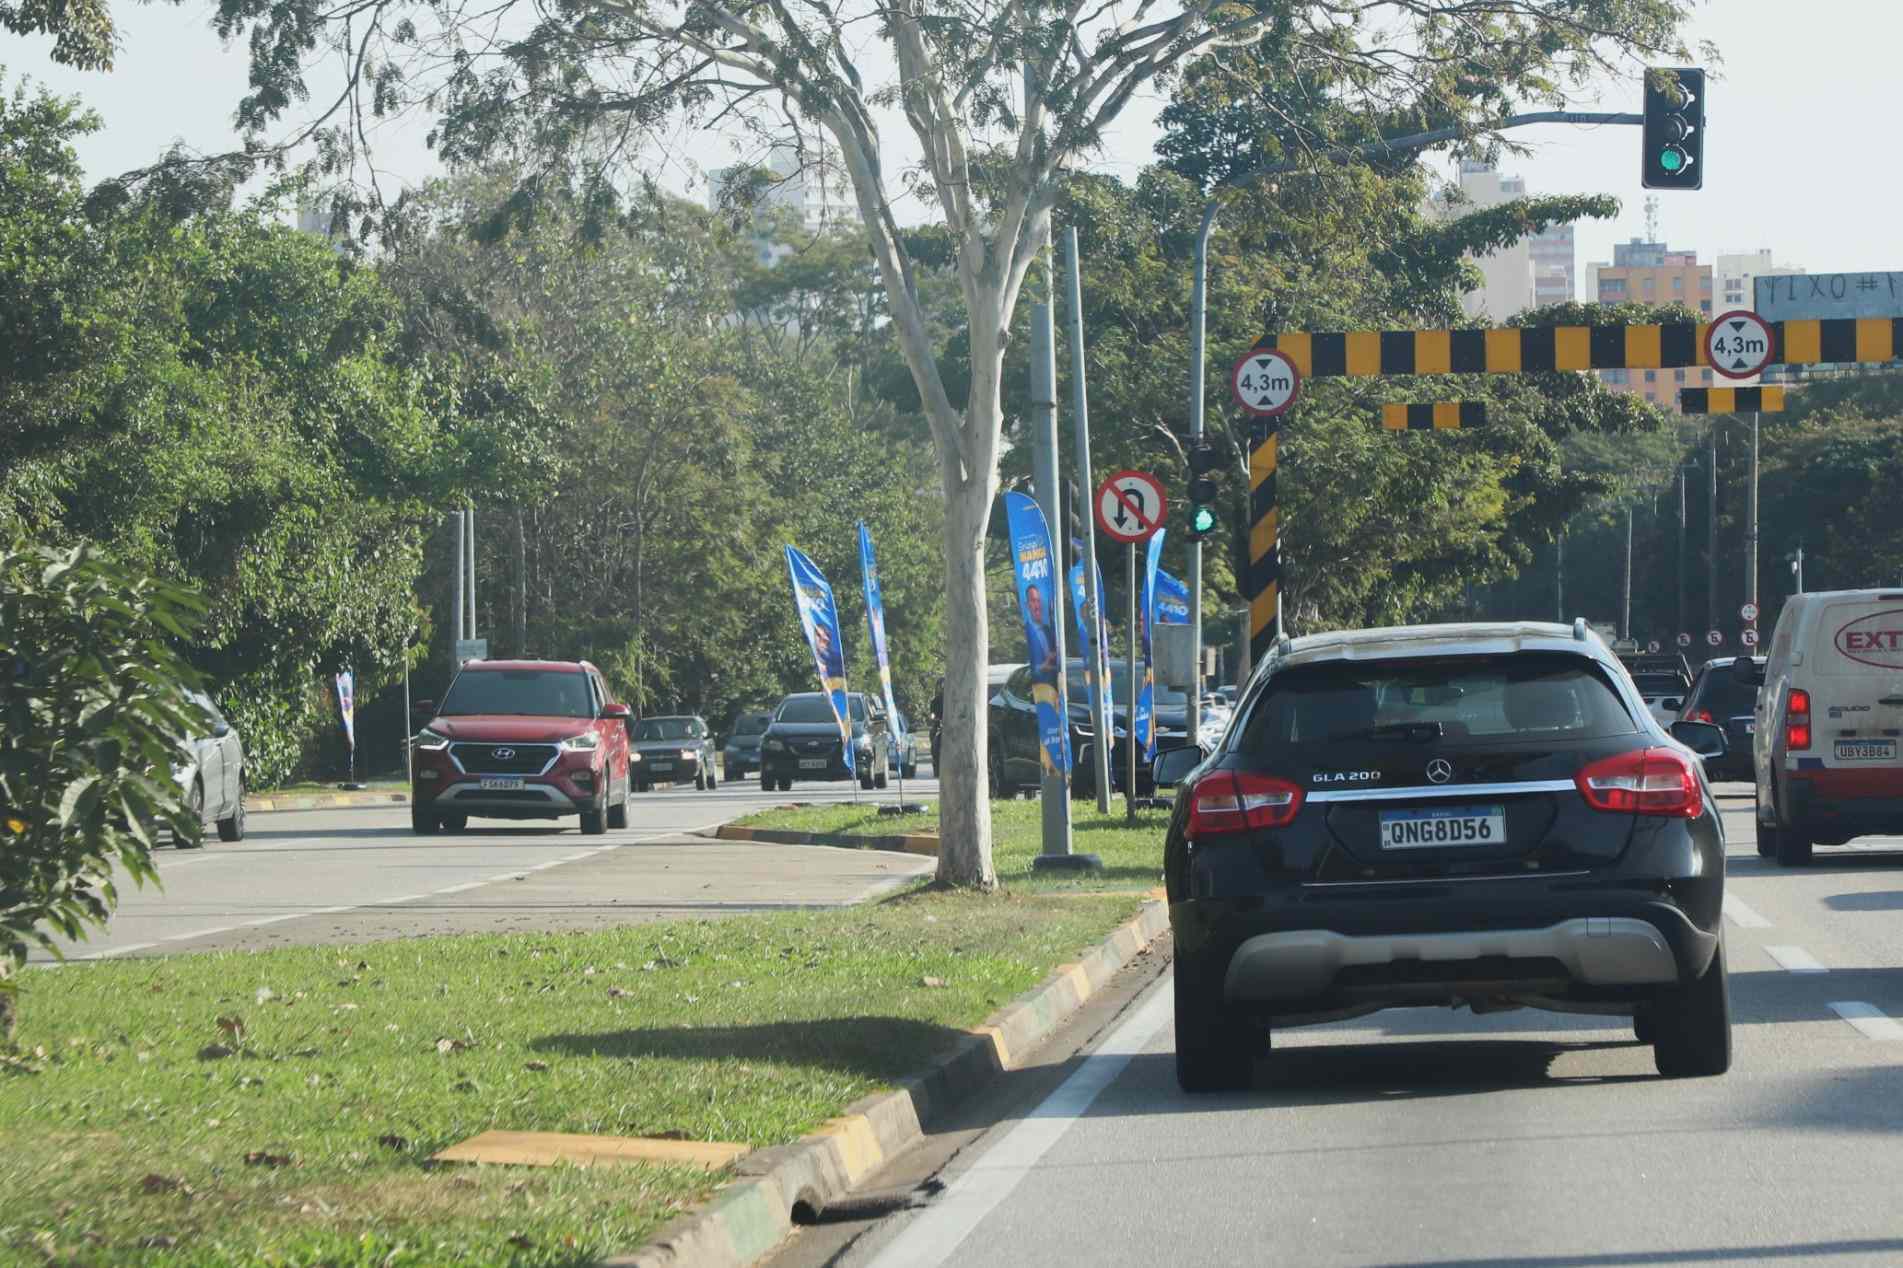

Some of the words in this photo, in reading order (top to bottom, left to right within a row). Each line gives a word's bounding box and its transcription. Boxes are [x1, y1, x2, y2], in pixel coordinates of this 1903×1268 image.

[1714, 336, 1764, 357] 4,3m
[1240, 374, 1289, 394] 4,3m
[1312, 771, 1345, 783] GLA
[1350, 770, 1381, 781] 200
[1391, 817, 1491, 845] QNG8D56
